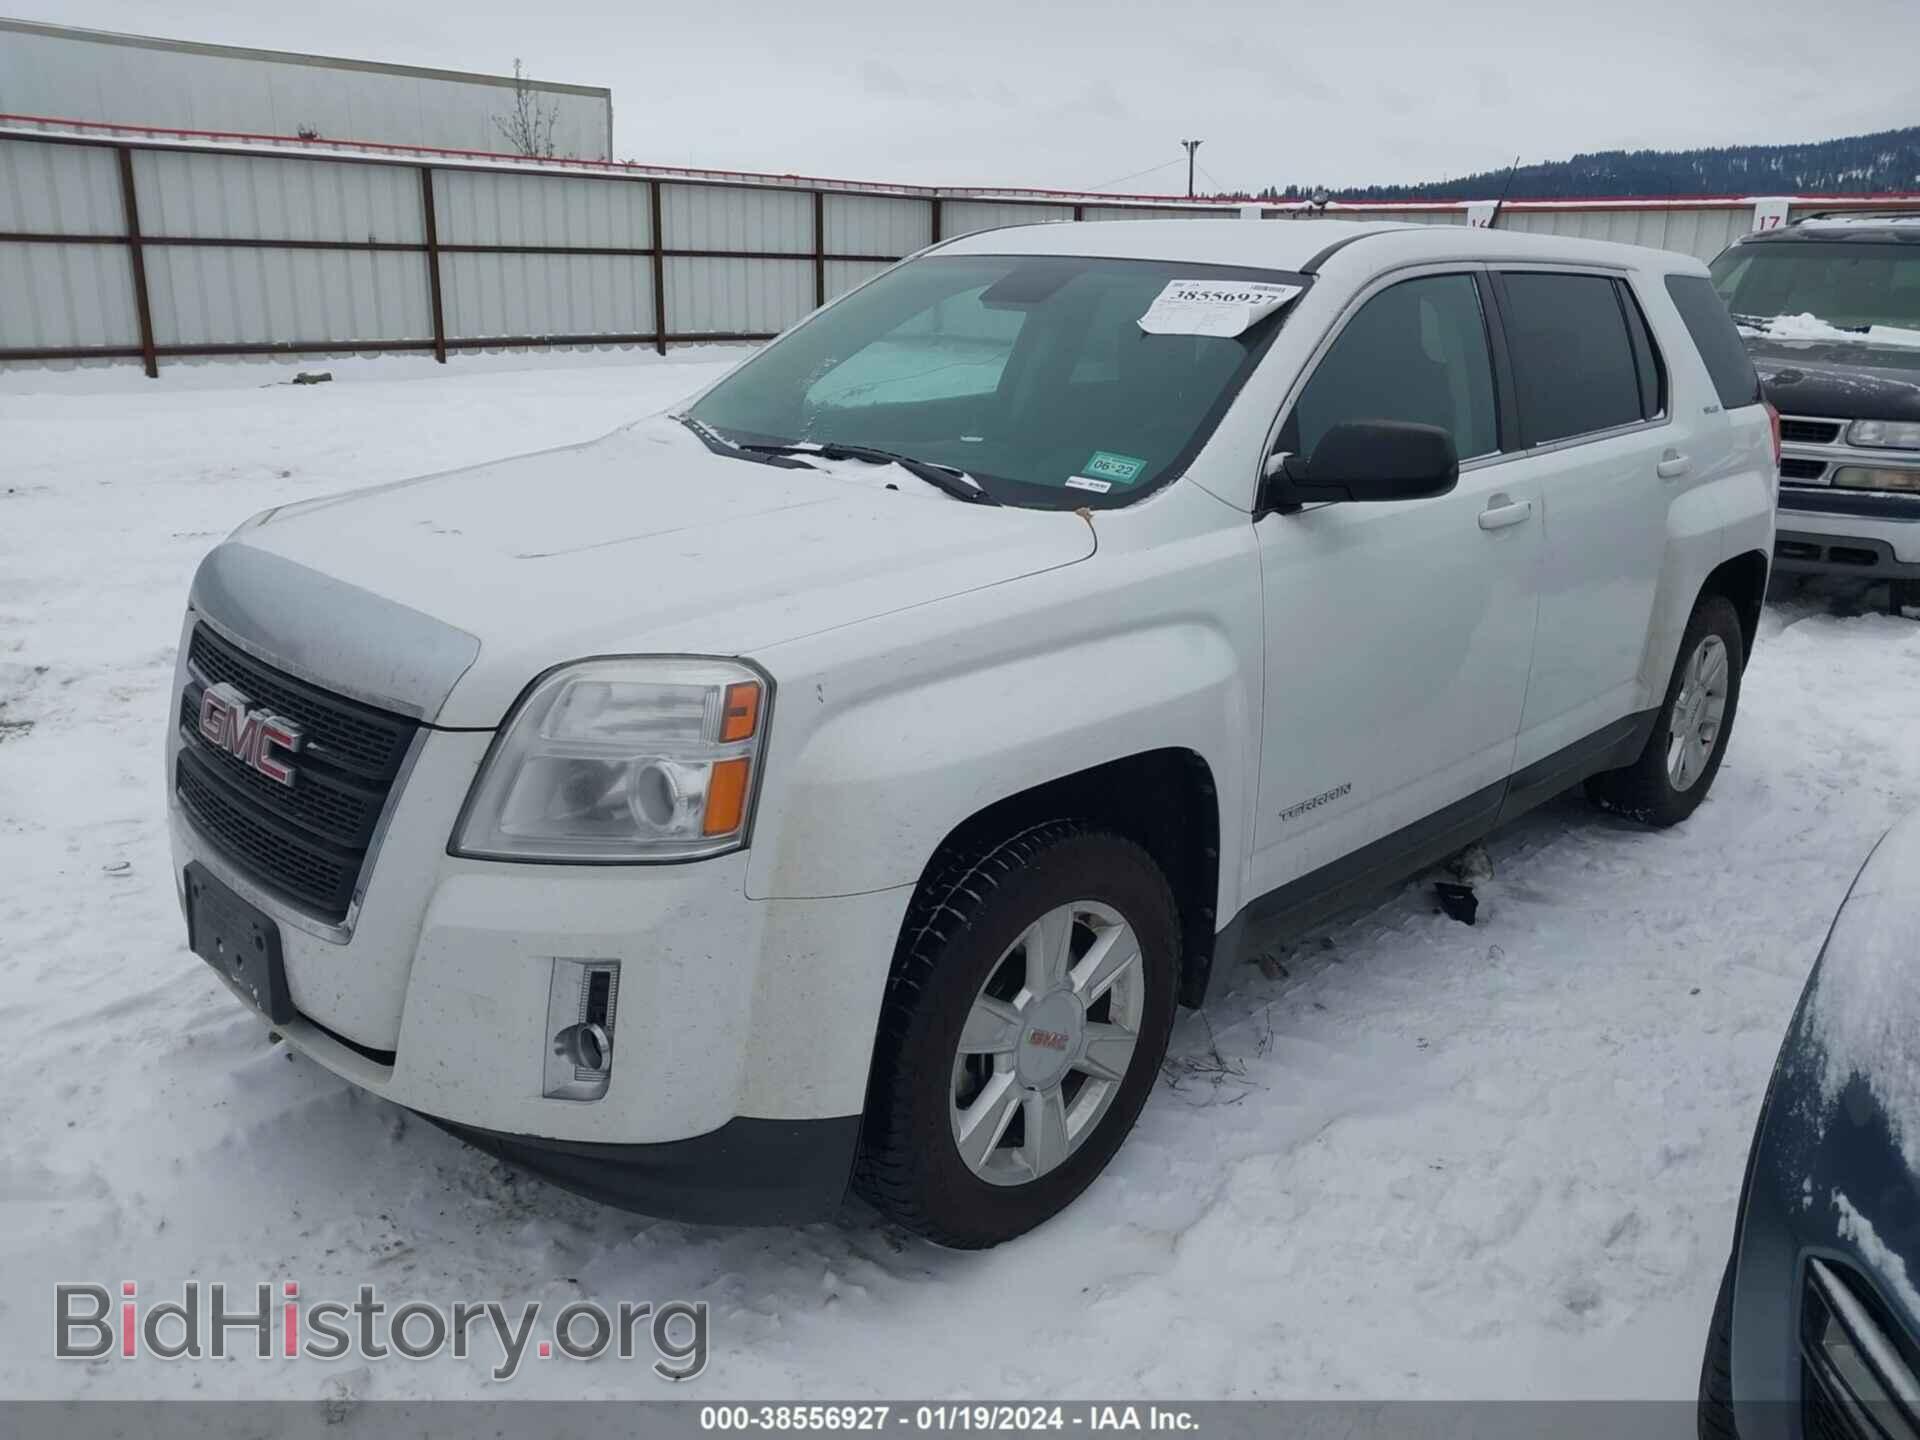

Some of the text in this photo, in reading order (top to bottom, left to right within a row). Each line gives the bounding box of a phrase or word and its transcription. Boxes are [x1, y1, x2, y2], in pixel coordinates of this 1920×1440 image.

[1760, 216, 1780, 230] 17
[1172, 289, 1278, 305] 38556927
[199, 682, 301, 787] GMC
